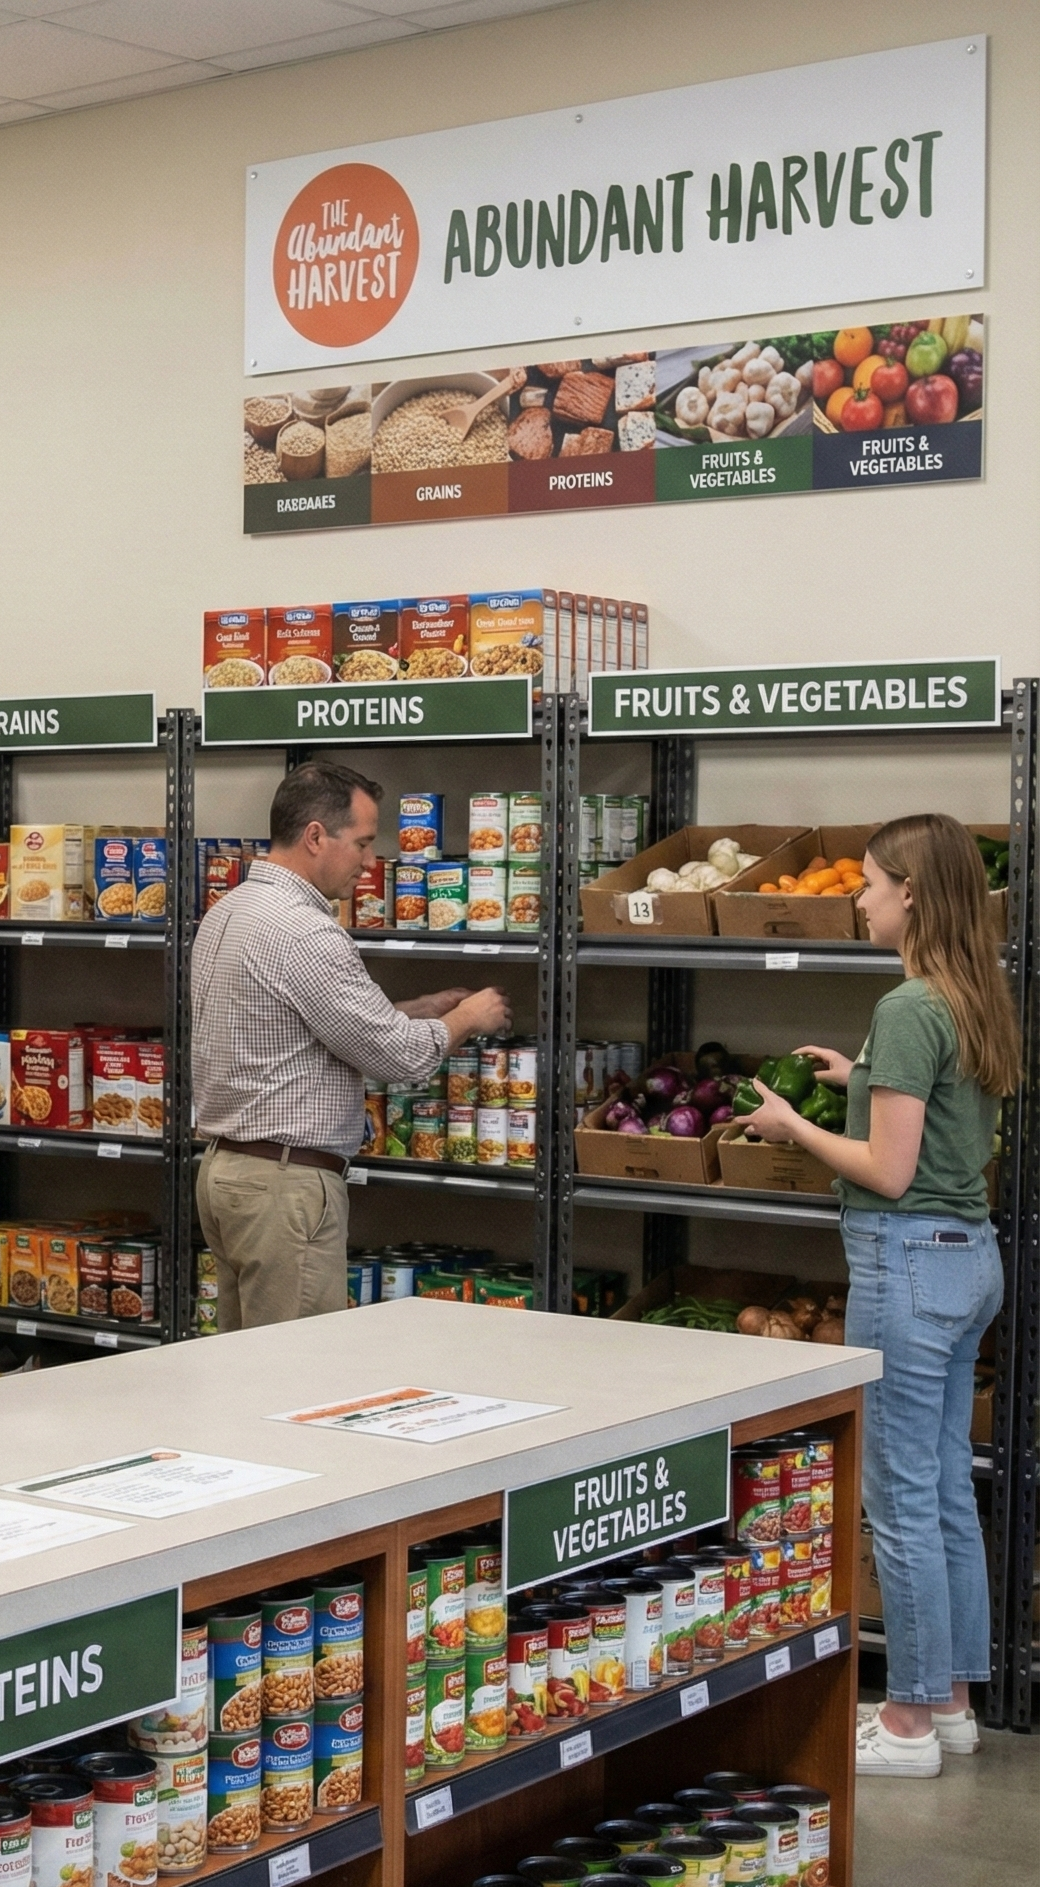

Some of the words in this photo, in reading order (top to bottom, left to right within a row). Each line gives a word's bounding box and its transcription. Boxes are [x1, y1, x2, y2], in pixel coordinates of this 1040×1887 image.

[321, 198, 350, 230] THE
[444, 170, 694, 284] ABUNDANT
[706, 130, 943, 244] HARVEST
[287, 251, 402, 310] HARVEST
[701, 451, 750, 470] FRUITS
[753, 449, 764, 465] &
[862, 435, 915, 456] FRUITS
[918, 435, 930, 451] &
[689, 467, 777, 489] VEGETABLES
[849, 453, 944, 477] VEGETABLES
[416, 484, 462, 502] GRAINS
[548, 471, 614, 491] PROTEINS
[614, 684, 721, 718] FRUITS
[728, 683, 751, 715] &
[757, 675, 968, 714] VEGETABLES
[297, 695, 425, 728] PROTEINS
[633, 901, 650, 918] 13
[574, 1461, 648, 1515] FRUITS
[654, 1456, 670, 1490] &
[553, 1490, 687, 1563] VEGETABLES
